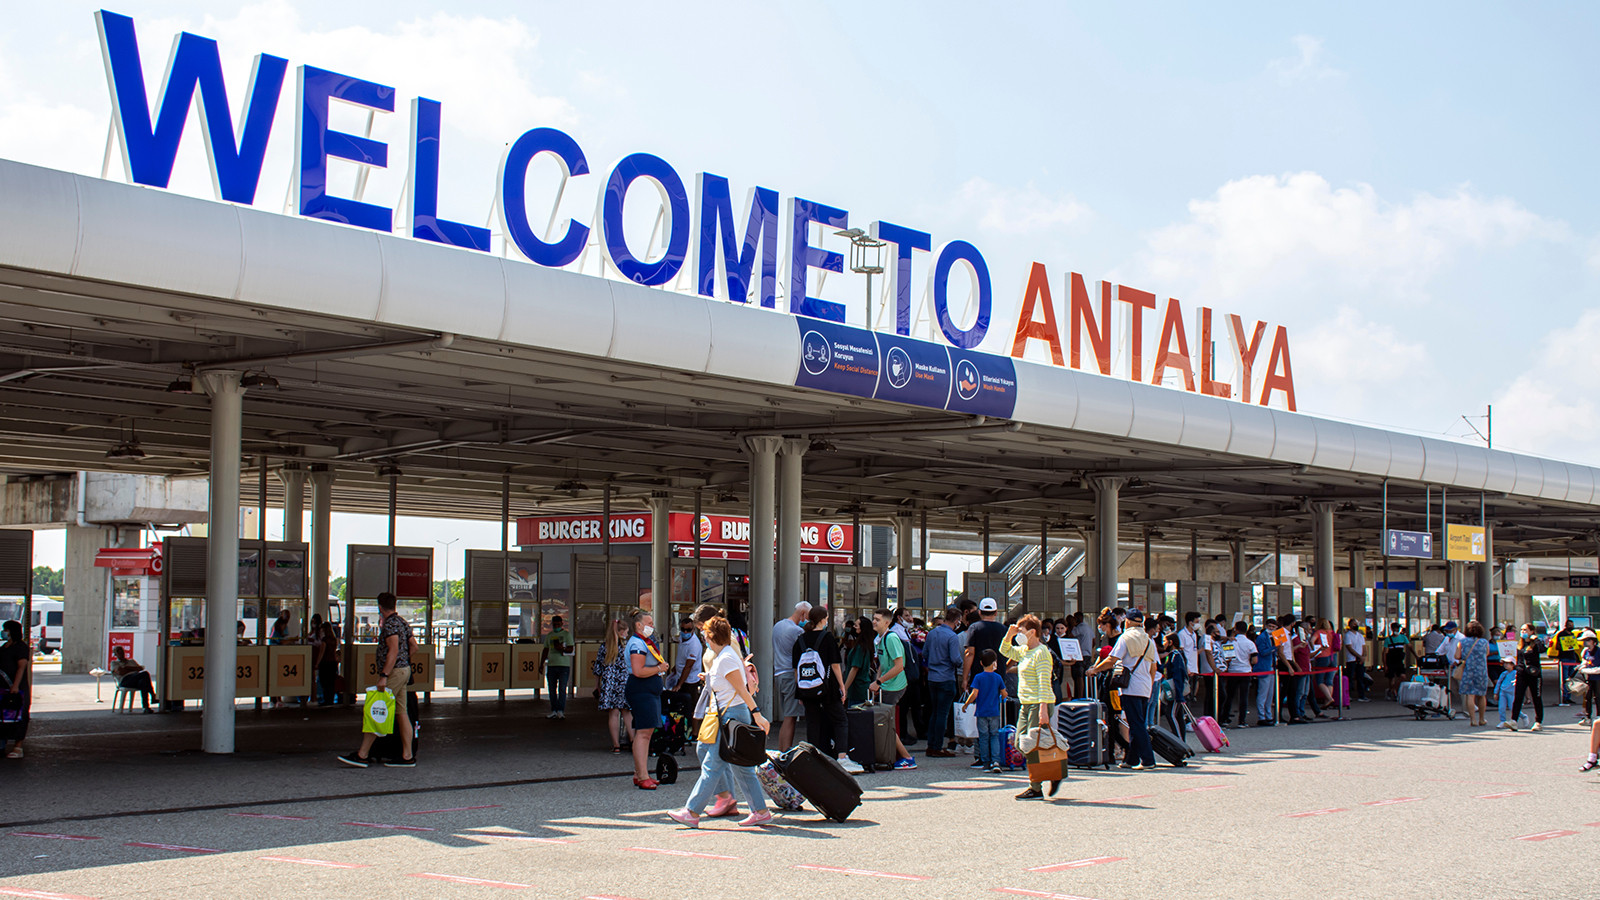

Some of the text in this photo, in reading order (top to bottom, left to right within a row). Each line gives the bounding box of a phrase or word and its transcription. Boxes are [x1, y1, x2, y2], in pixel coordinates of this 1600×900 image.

[94, 9, 1297, 412] WELCOME TO ANTALYA
[833, 342, 849, 351] Sosyal
[833, 352, 854, 361] Koruyun
[833, 362, 846, 371] Keep
[846, 364, 860, 373] Social
[538, 519, 601, 541] BURGER
[237, 665, 252, 679] 33
[282, 664, 298, 677] 34
[411, 663, 424, 674] 36
[486, 662, 499, 674] 37
[522, 660, 534, 672] 38
[188, 666, 204, 680] 32
